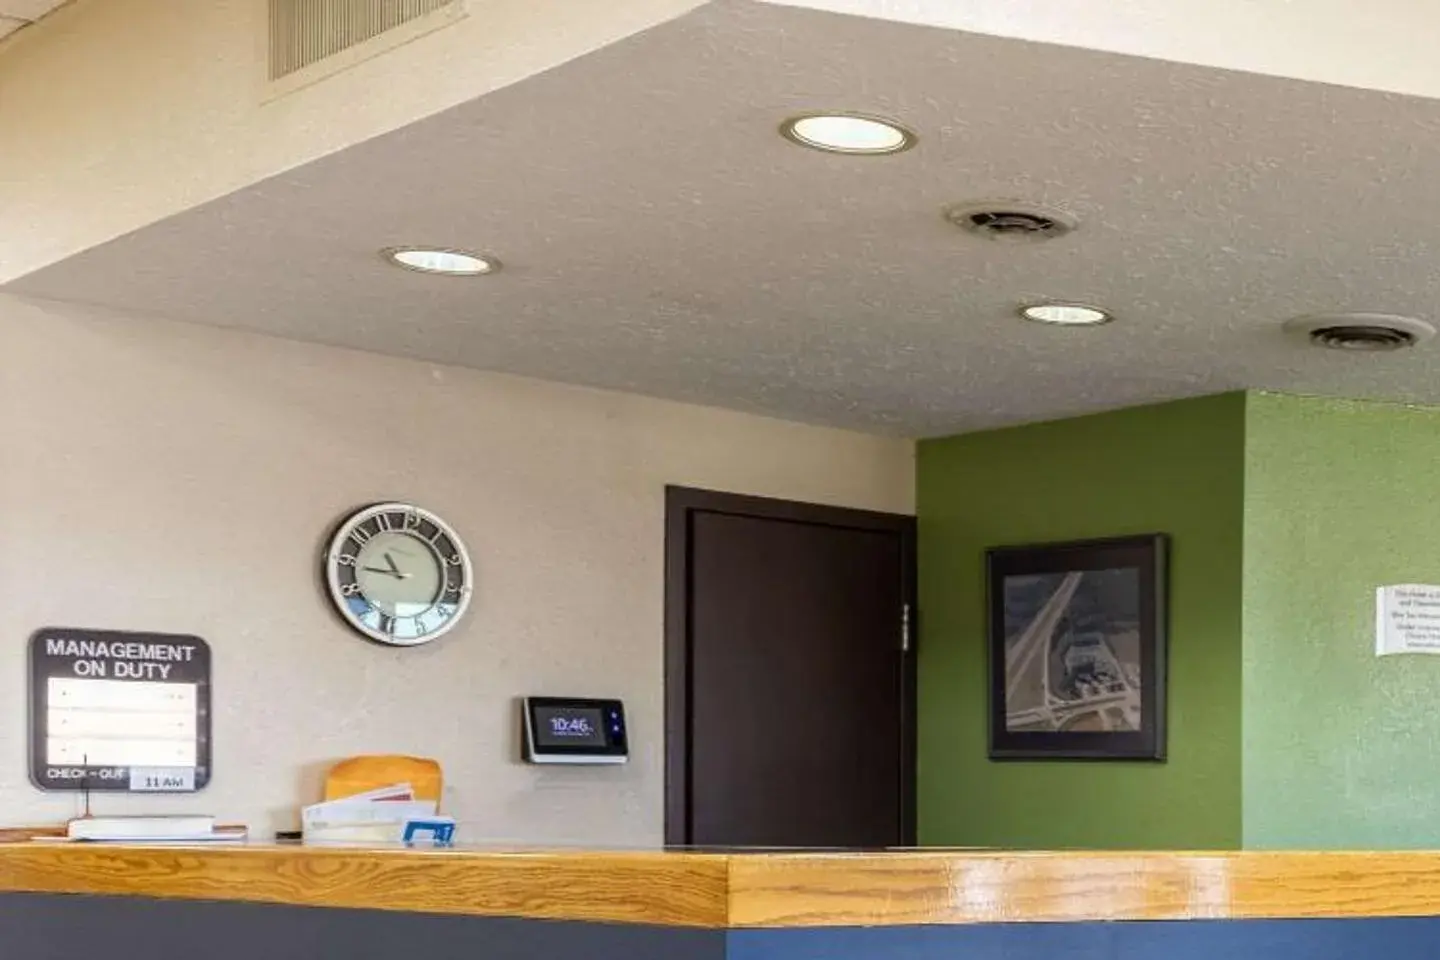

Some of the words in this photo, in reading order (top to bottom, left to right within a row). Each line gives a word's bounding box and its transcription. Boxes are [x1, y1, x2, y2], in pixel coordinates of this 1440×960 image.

[46, 639, 196, 661] MANAGEMENT
[74, 659, 105, 677] ON
[115, 662, 171, 679] DUTY
[145, 776, 160, 788] 11
[163, 777, 184, 788] AM
